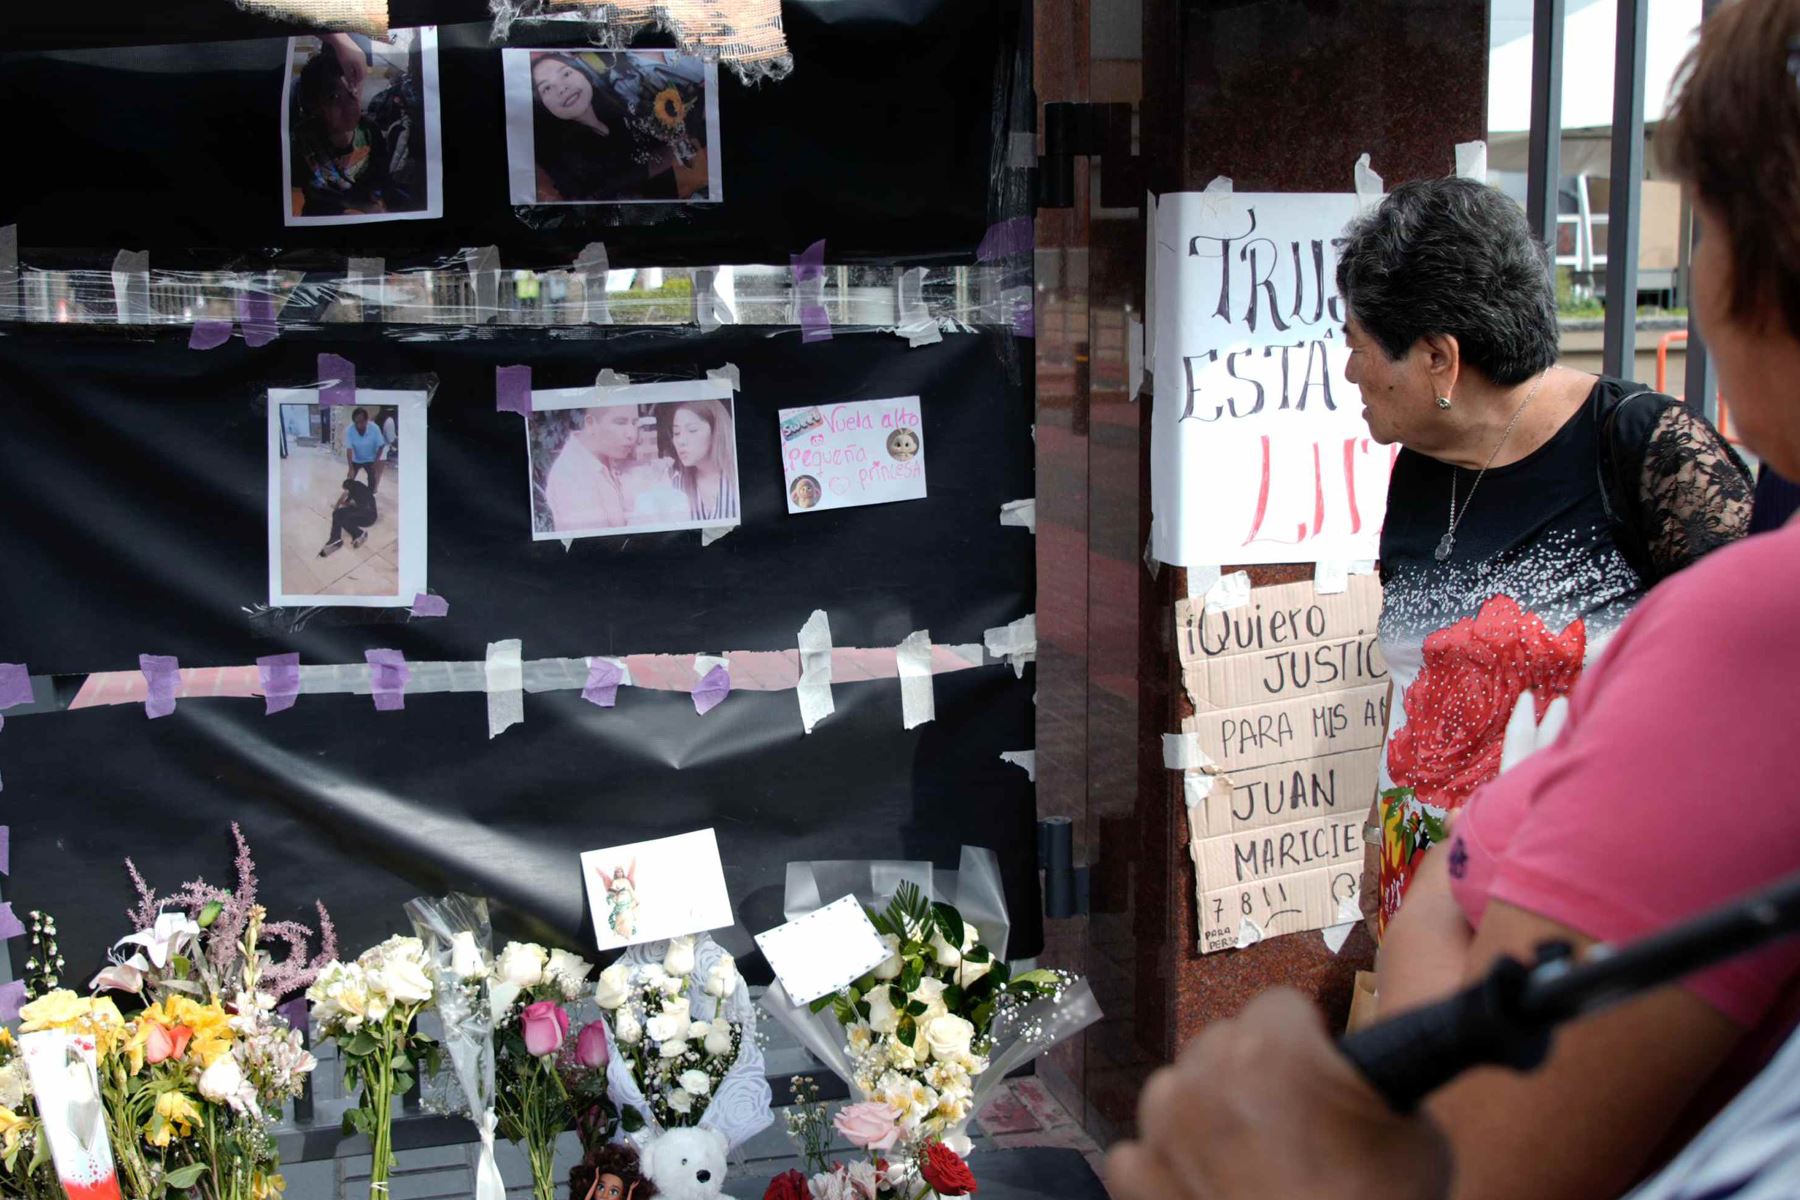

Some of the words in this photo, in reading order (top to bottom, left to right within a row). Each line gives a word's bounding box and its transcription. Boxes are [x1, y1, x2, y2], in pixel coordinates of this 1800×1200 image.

[1179, 328, 1337, 422] ESTÁ
[824, 405, 873, 433] Vuela
[880, 407, 919, 427] alto
[1221, 711, 1293, 758] PARA
[1312, 703, 1348, 739] MIS
[1232, 769, 1335, 821] JUAN
[1234, 823, 1360, 882] MARICIE
[1204, 926, 1232, 940] PARA
